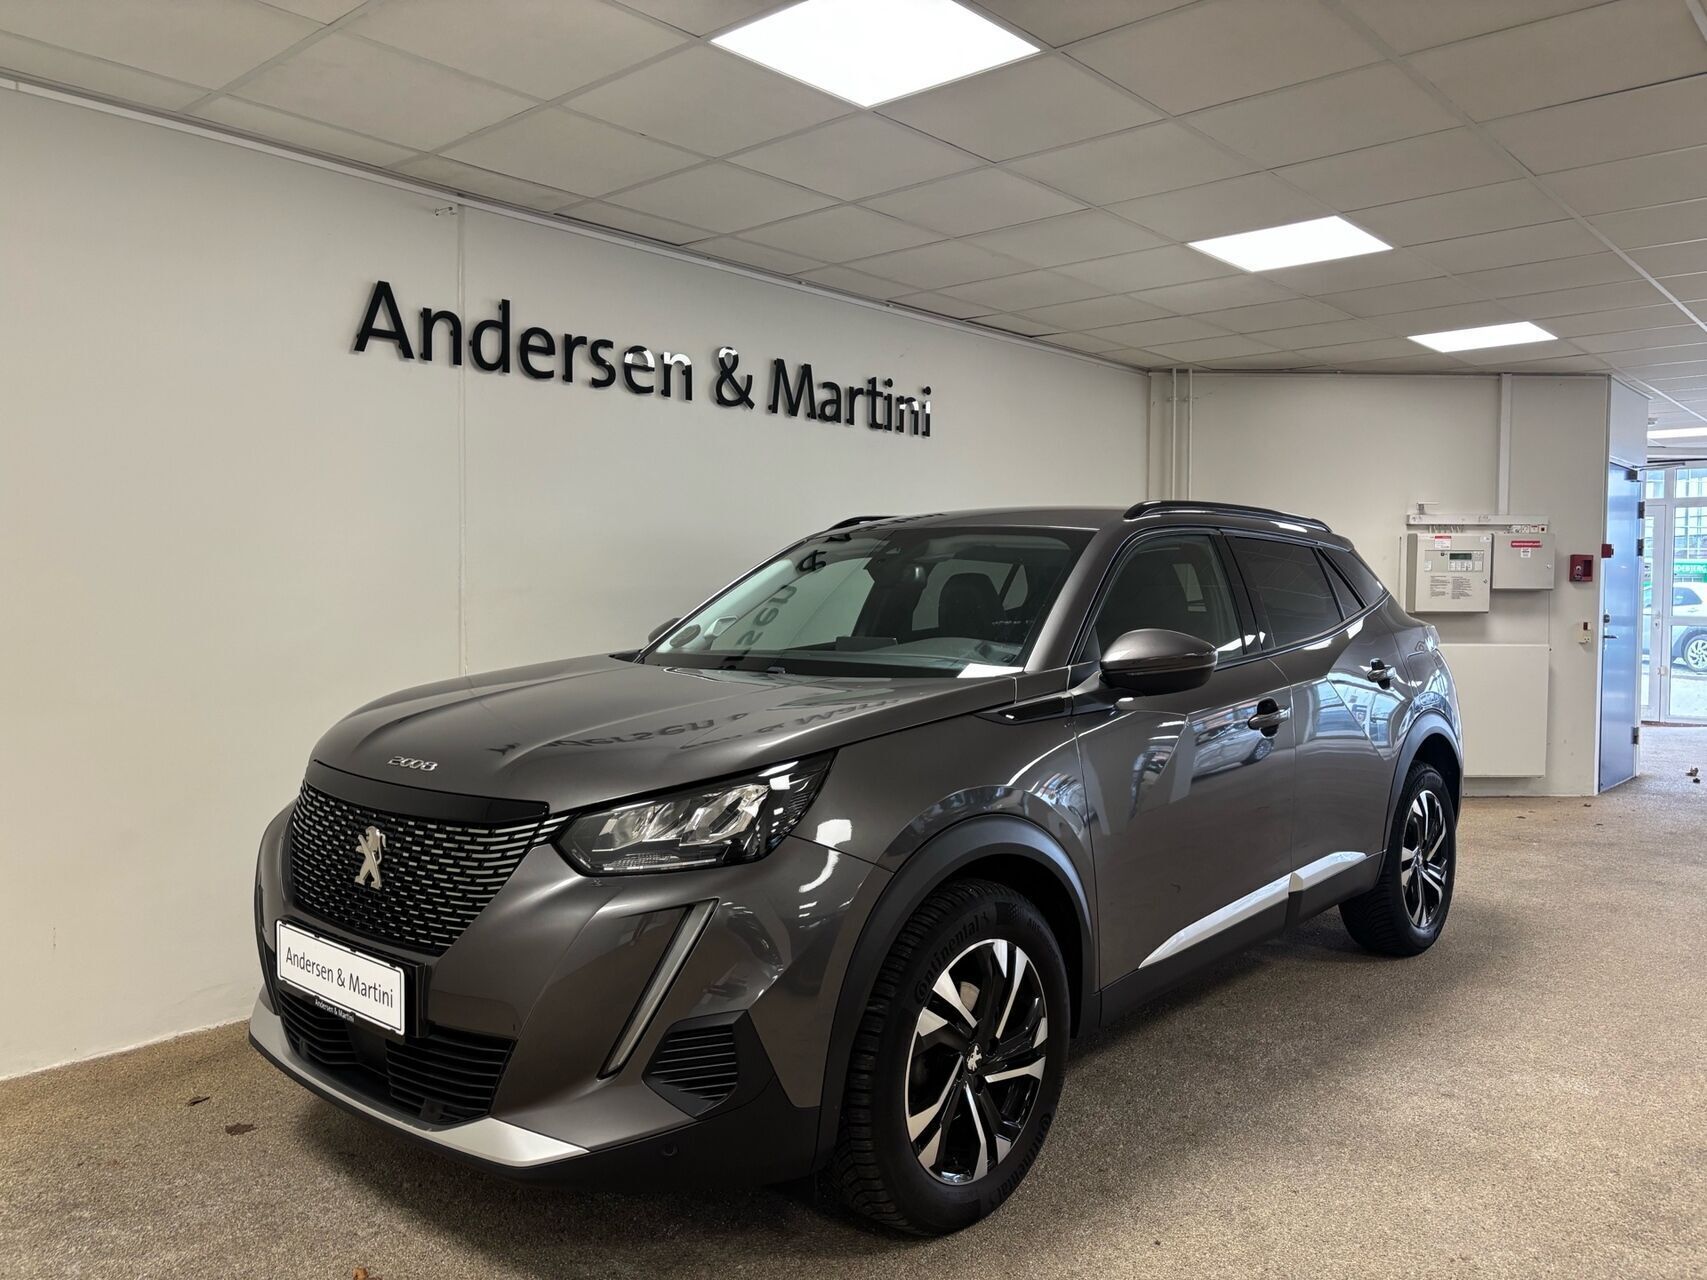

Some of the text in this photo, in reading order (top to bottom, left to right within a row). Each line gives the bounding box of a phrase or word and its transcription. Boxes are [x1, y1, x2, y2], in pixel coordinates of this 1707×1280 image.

[353, 279, 932, 438] Andersen & Martini
[387, 755, 438, 771] 2008
[285, 946, 394, 1009] Andersen & Martini
